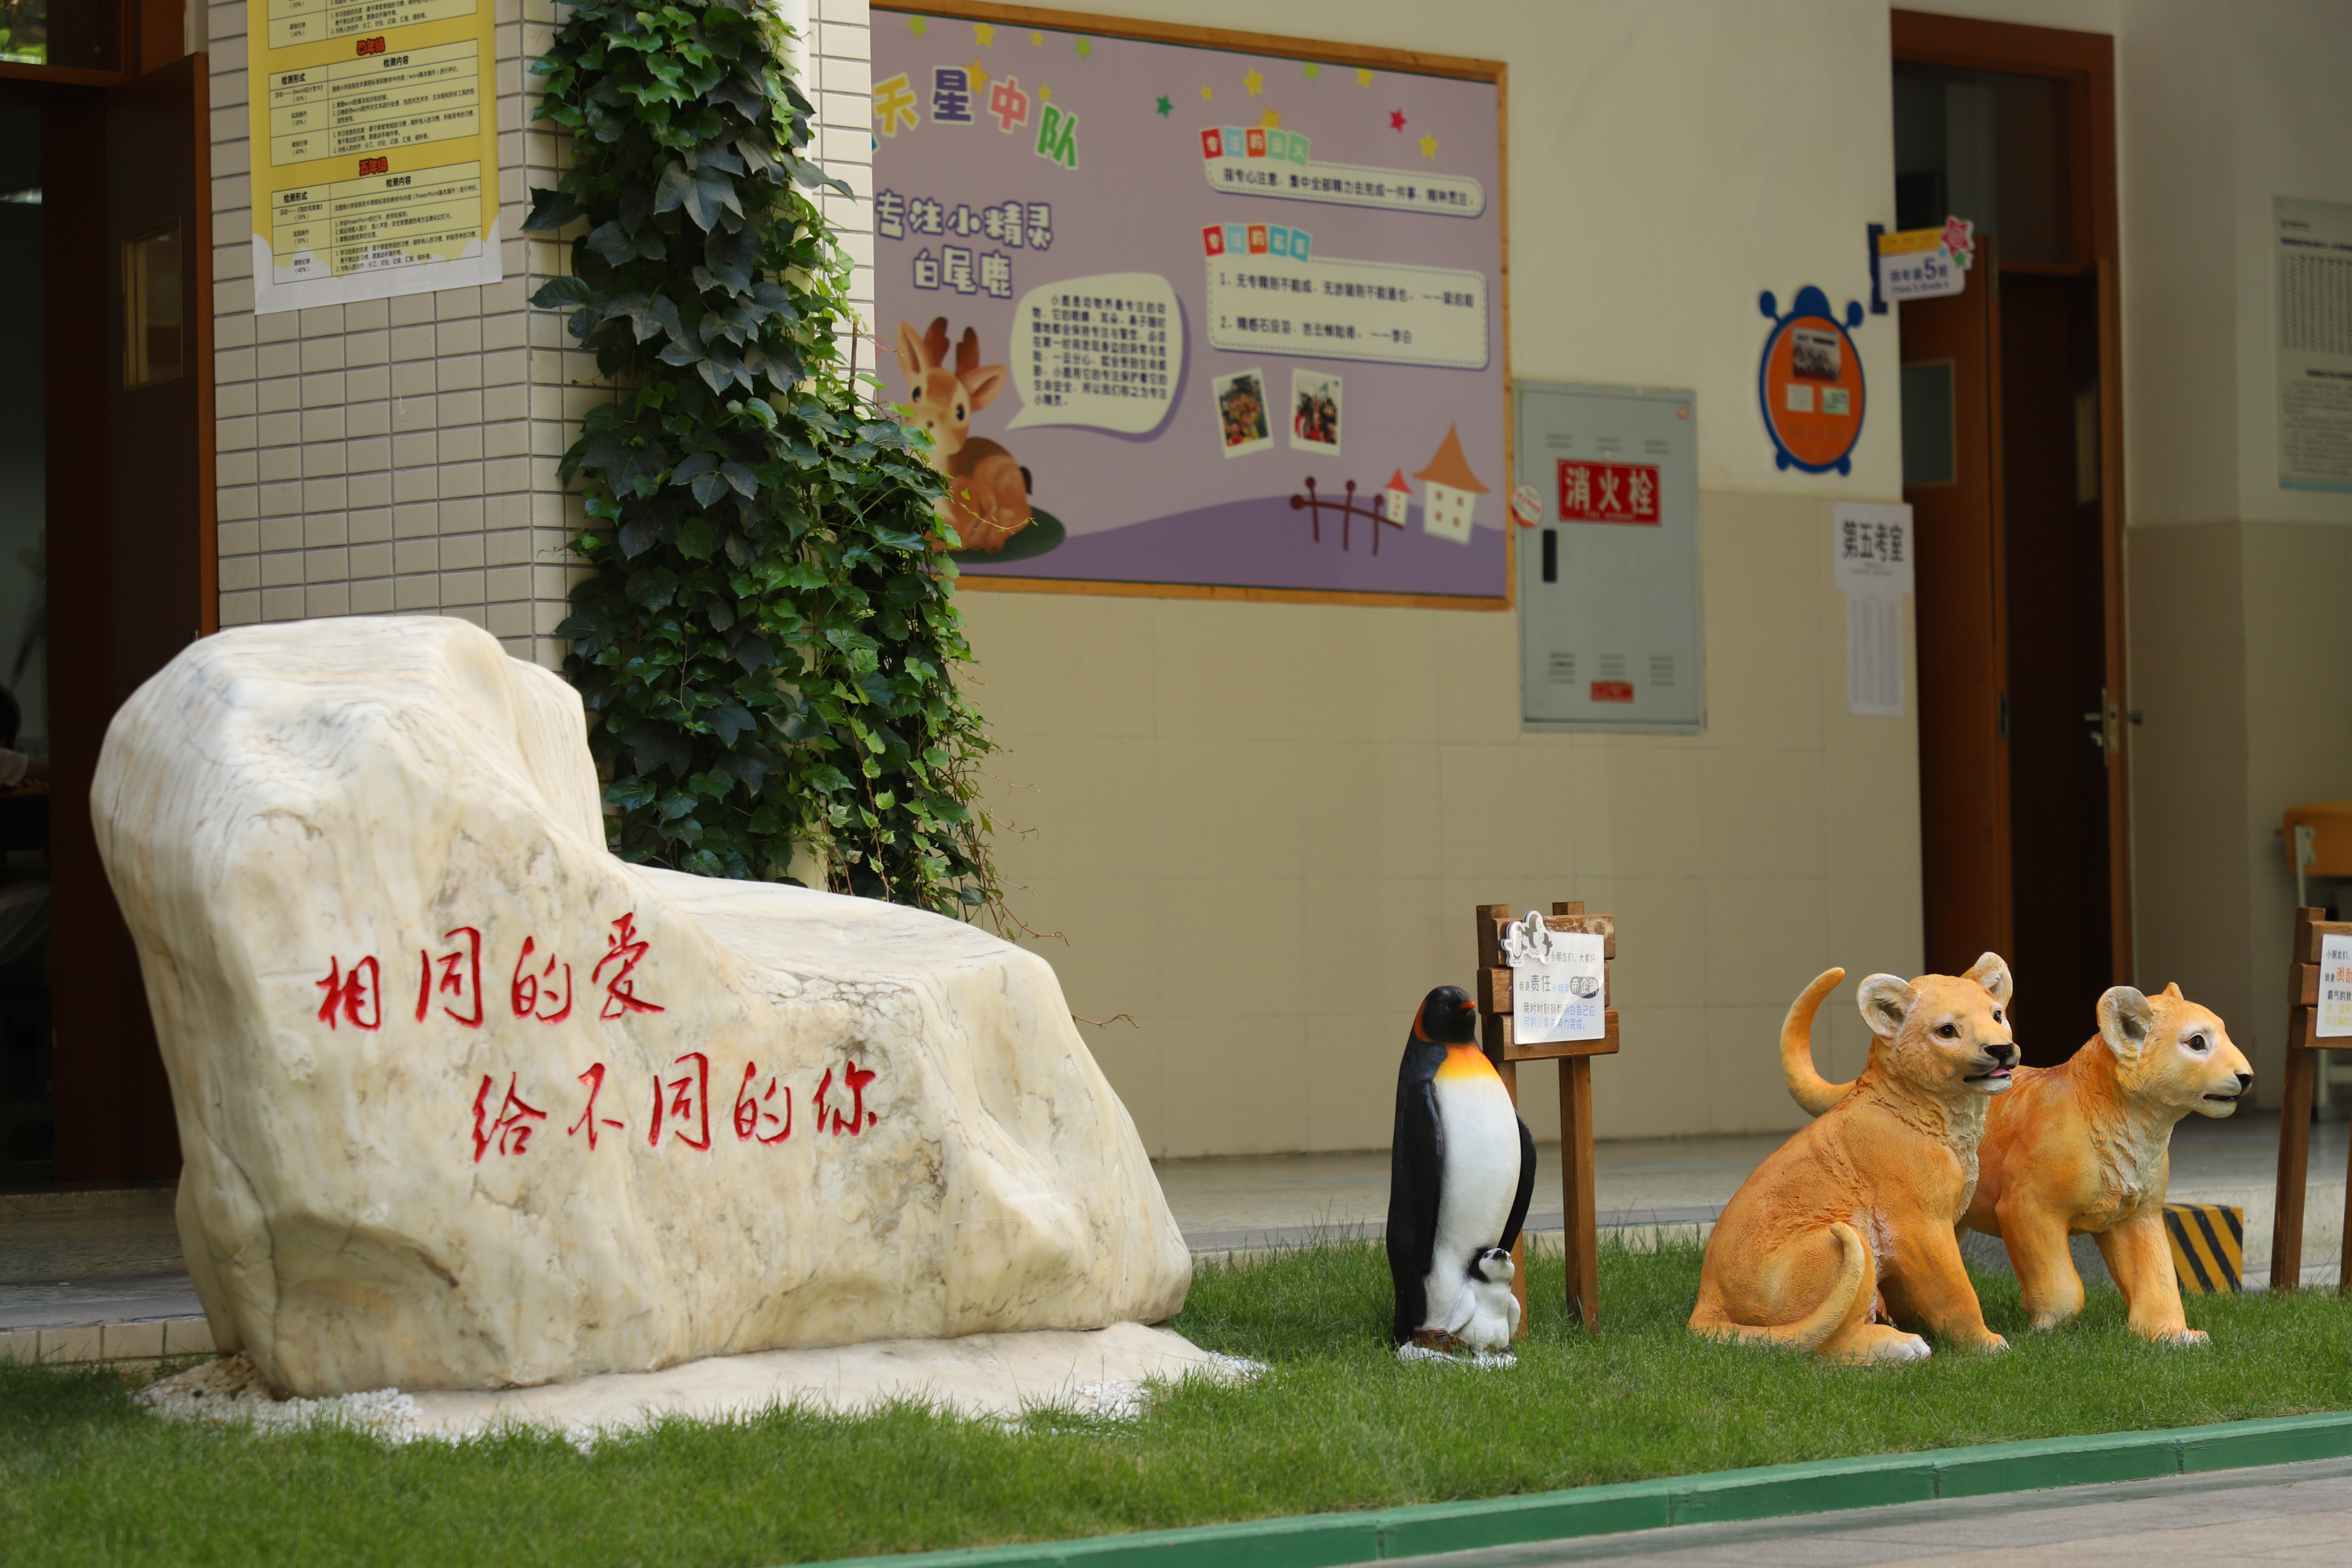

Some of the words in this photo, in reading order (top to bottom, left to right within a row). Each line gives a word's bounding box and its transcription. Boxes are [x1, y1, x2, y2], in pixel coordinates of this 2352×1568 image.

[356, 37, 386, 56] 四年级
[383, 55, 409, 68] 检测内容
[282, 73, 305, 85] 检测形式
[870, 65, 1079, 170] 天星中队
[359, 156, 389, 177] 五年级
[386, 176, 411, 188] 检测内容
[284, 191, 307, 203] 检测形式
[874, 188, 1054, 251] 专注小精灵
[912, 244, 1013, 300] 白尾鹿
[1565, 466, 1654, 515] 消火栓
[1843, 520, 1904, 562] 第五考室
[317, 913, 664, 1029] 相同的爱
[473, 1052, 876, 1161] 给不同的你
